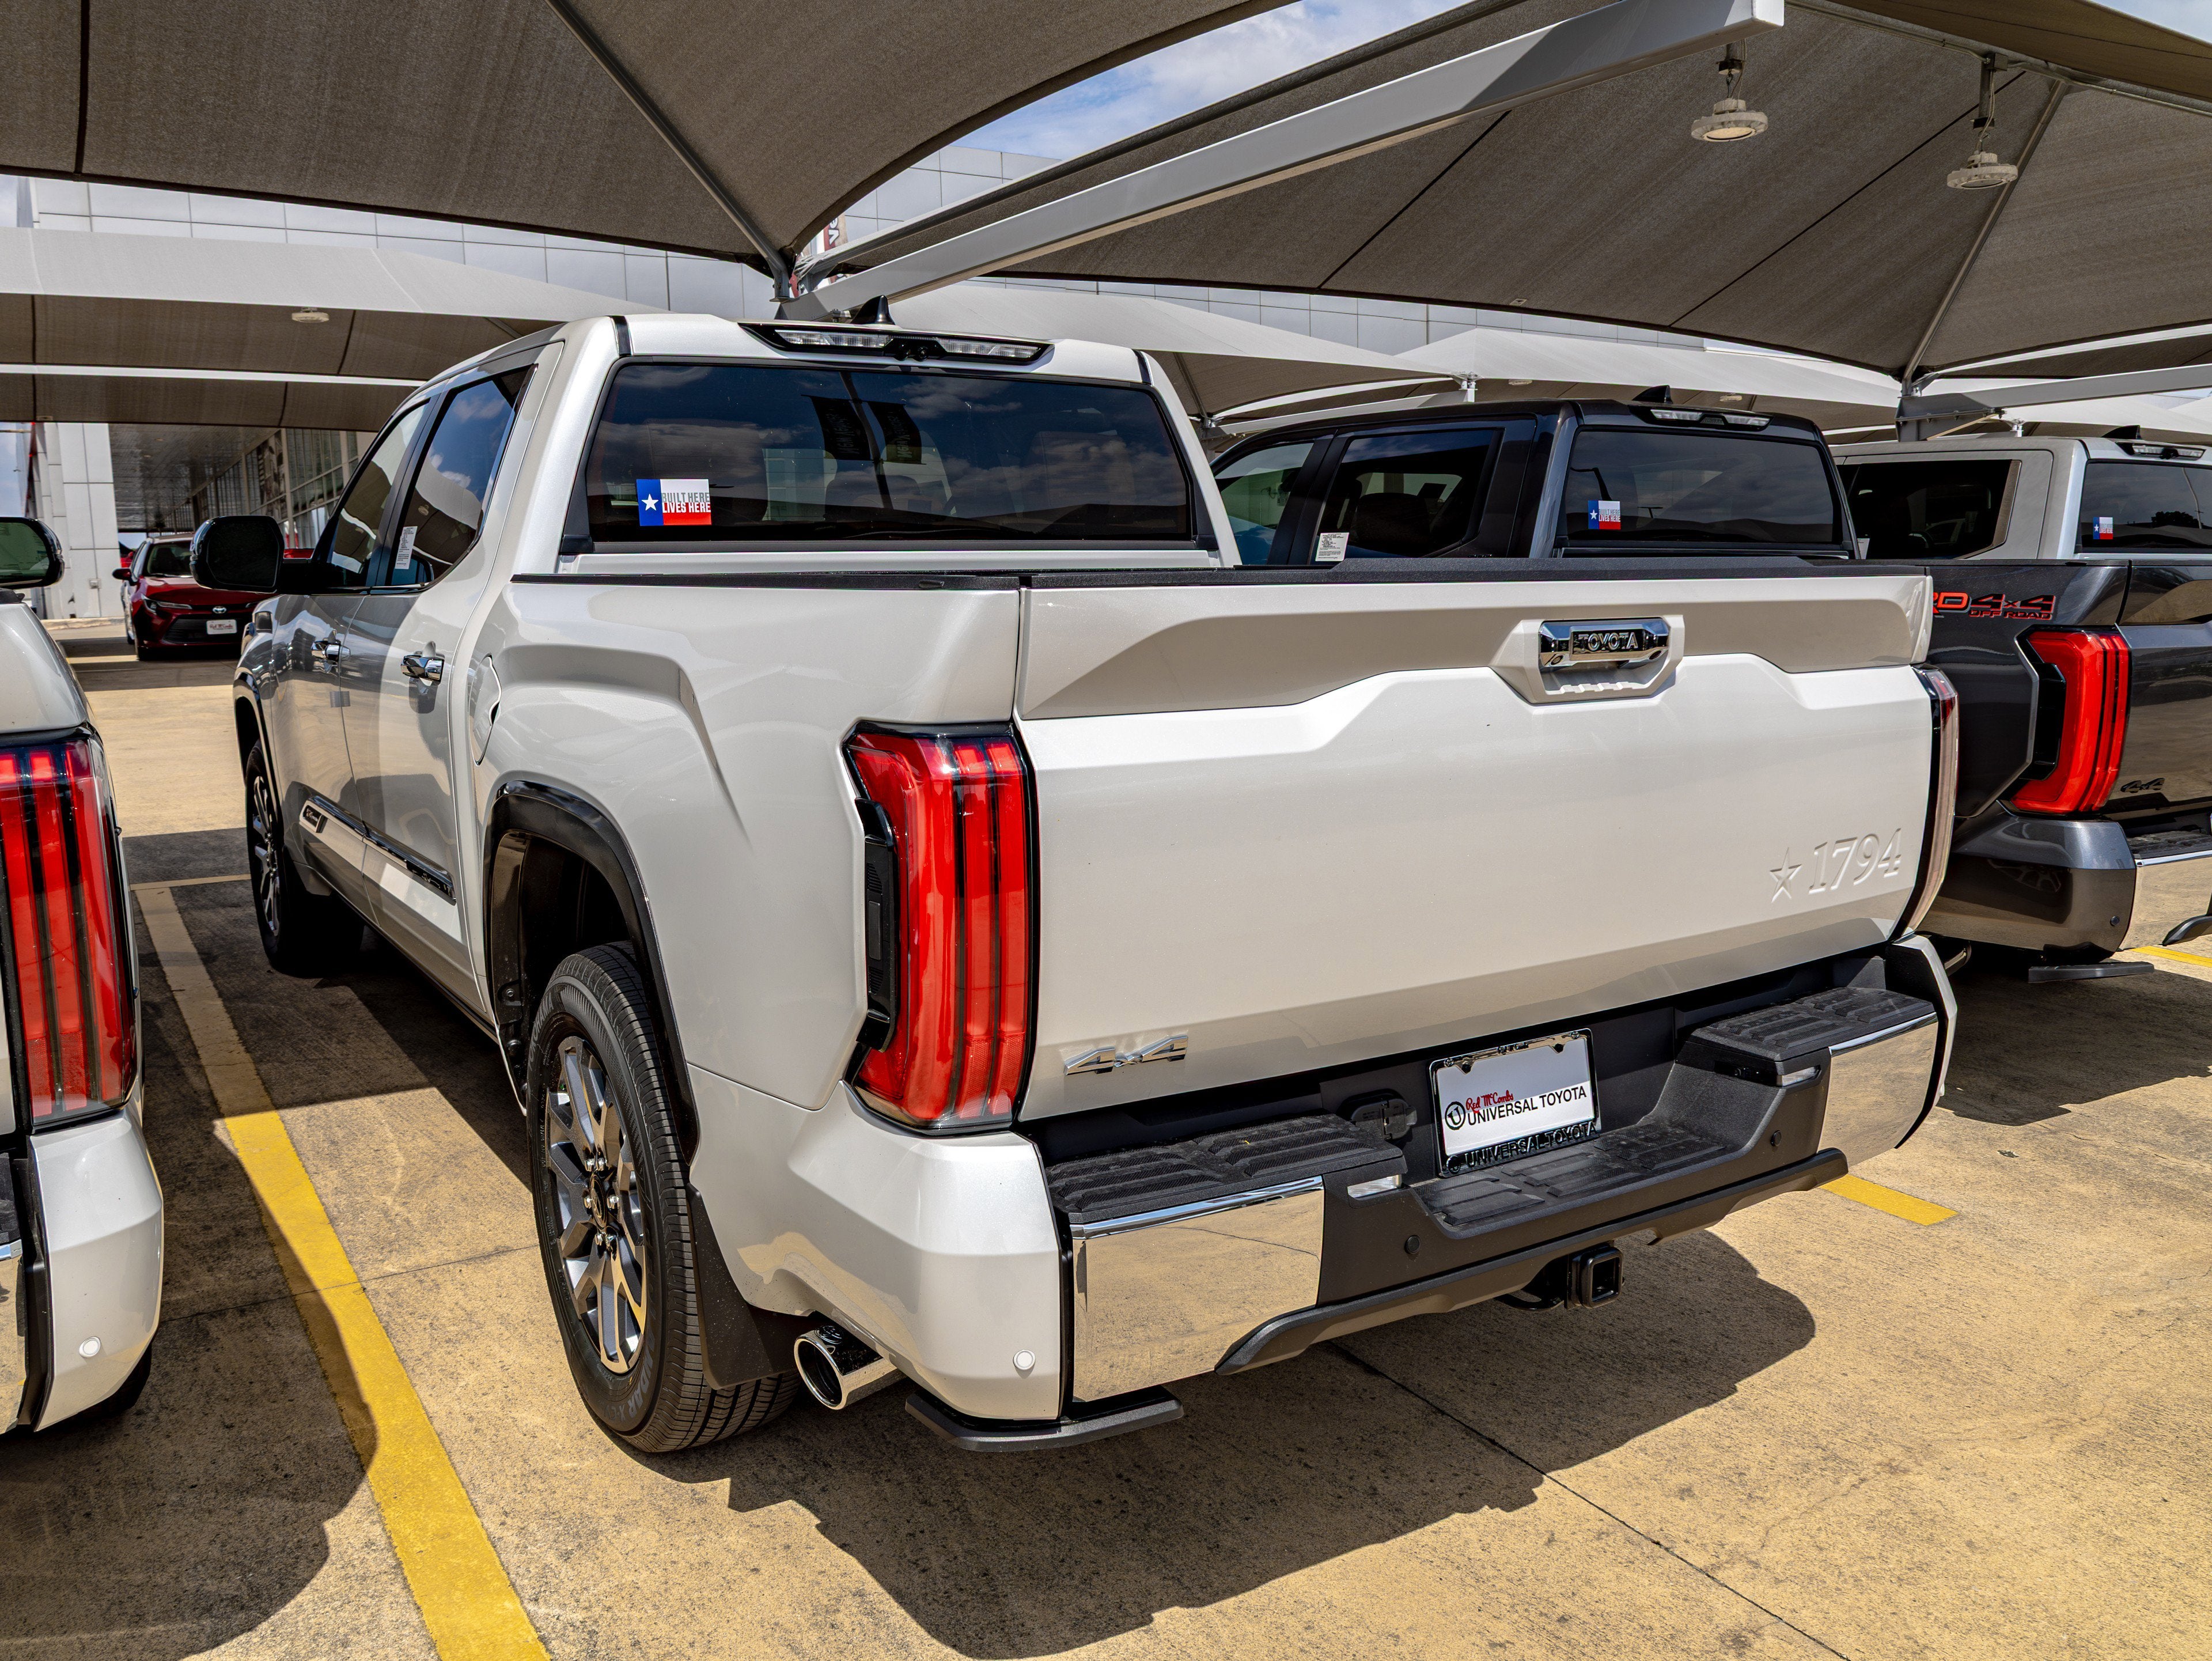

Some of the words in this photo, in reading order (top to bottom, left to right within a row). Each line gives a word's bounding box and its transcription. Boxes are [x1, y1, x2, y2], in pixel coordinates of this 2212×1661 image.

[662, 493, 686, 502] BUILT
[688, 493, 710, 502] HERE
[662, 502, 687, 513] LIVES
[689, 502, 711, 513] HERE
[1971, 593, 2055, 613] 4x4
[1968, 610, 2002, 618] OFF
[2003, 611, 2053, 620] ROAD
[1578, 631, 1639, 651] TOYOTA
[1808, 827, 1902, 894] 1794
[1063, 1034, 1189, 1076] 4x4
[1465, 1097, 1481, 1112] Red
[1467, 1097, 1539, 1126] UNIVERSAL
[1539, 1085, 1588, 1107] TOYOTA
[1464, 1133, 1544, 1169] UNIVERSAL
[1545, 1120, 1598, 1147] TOYOTA
